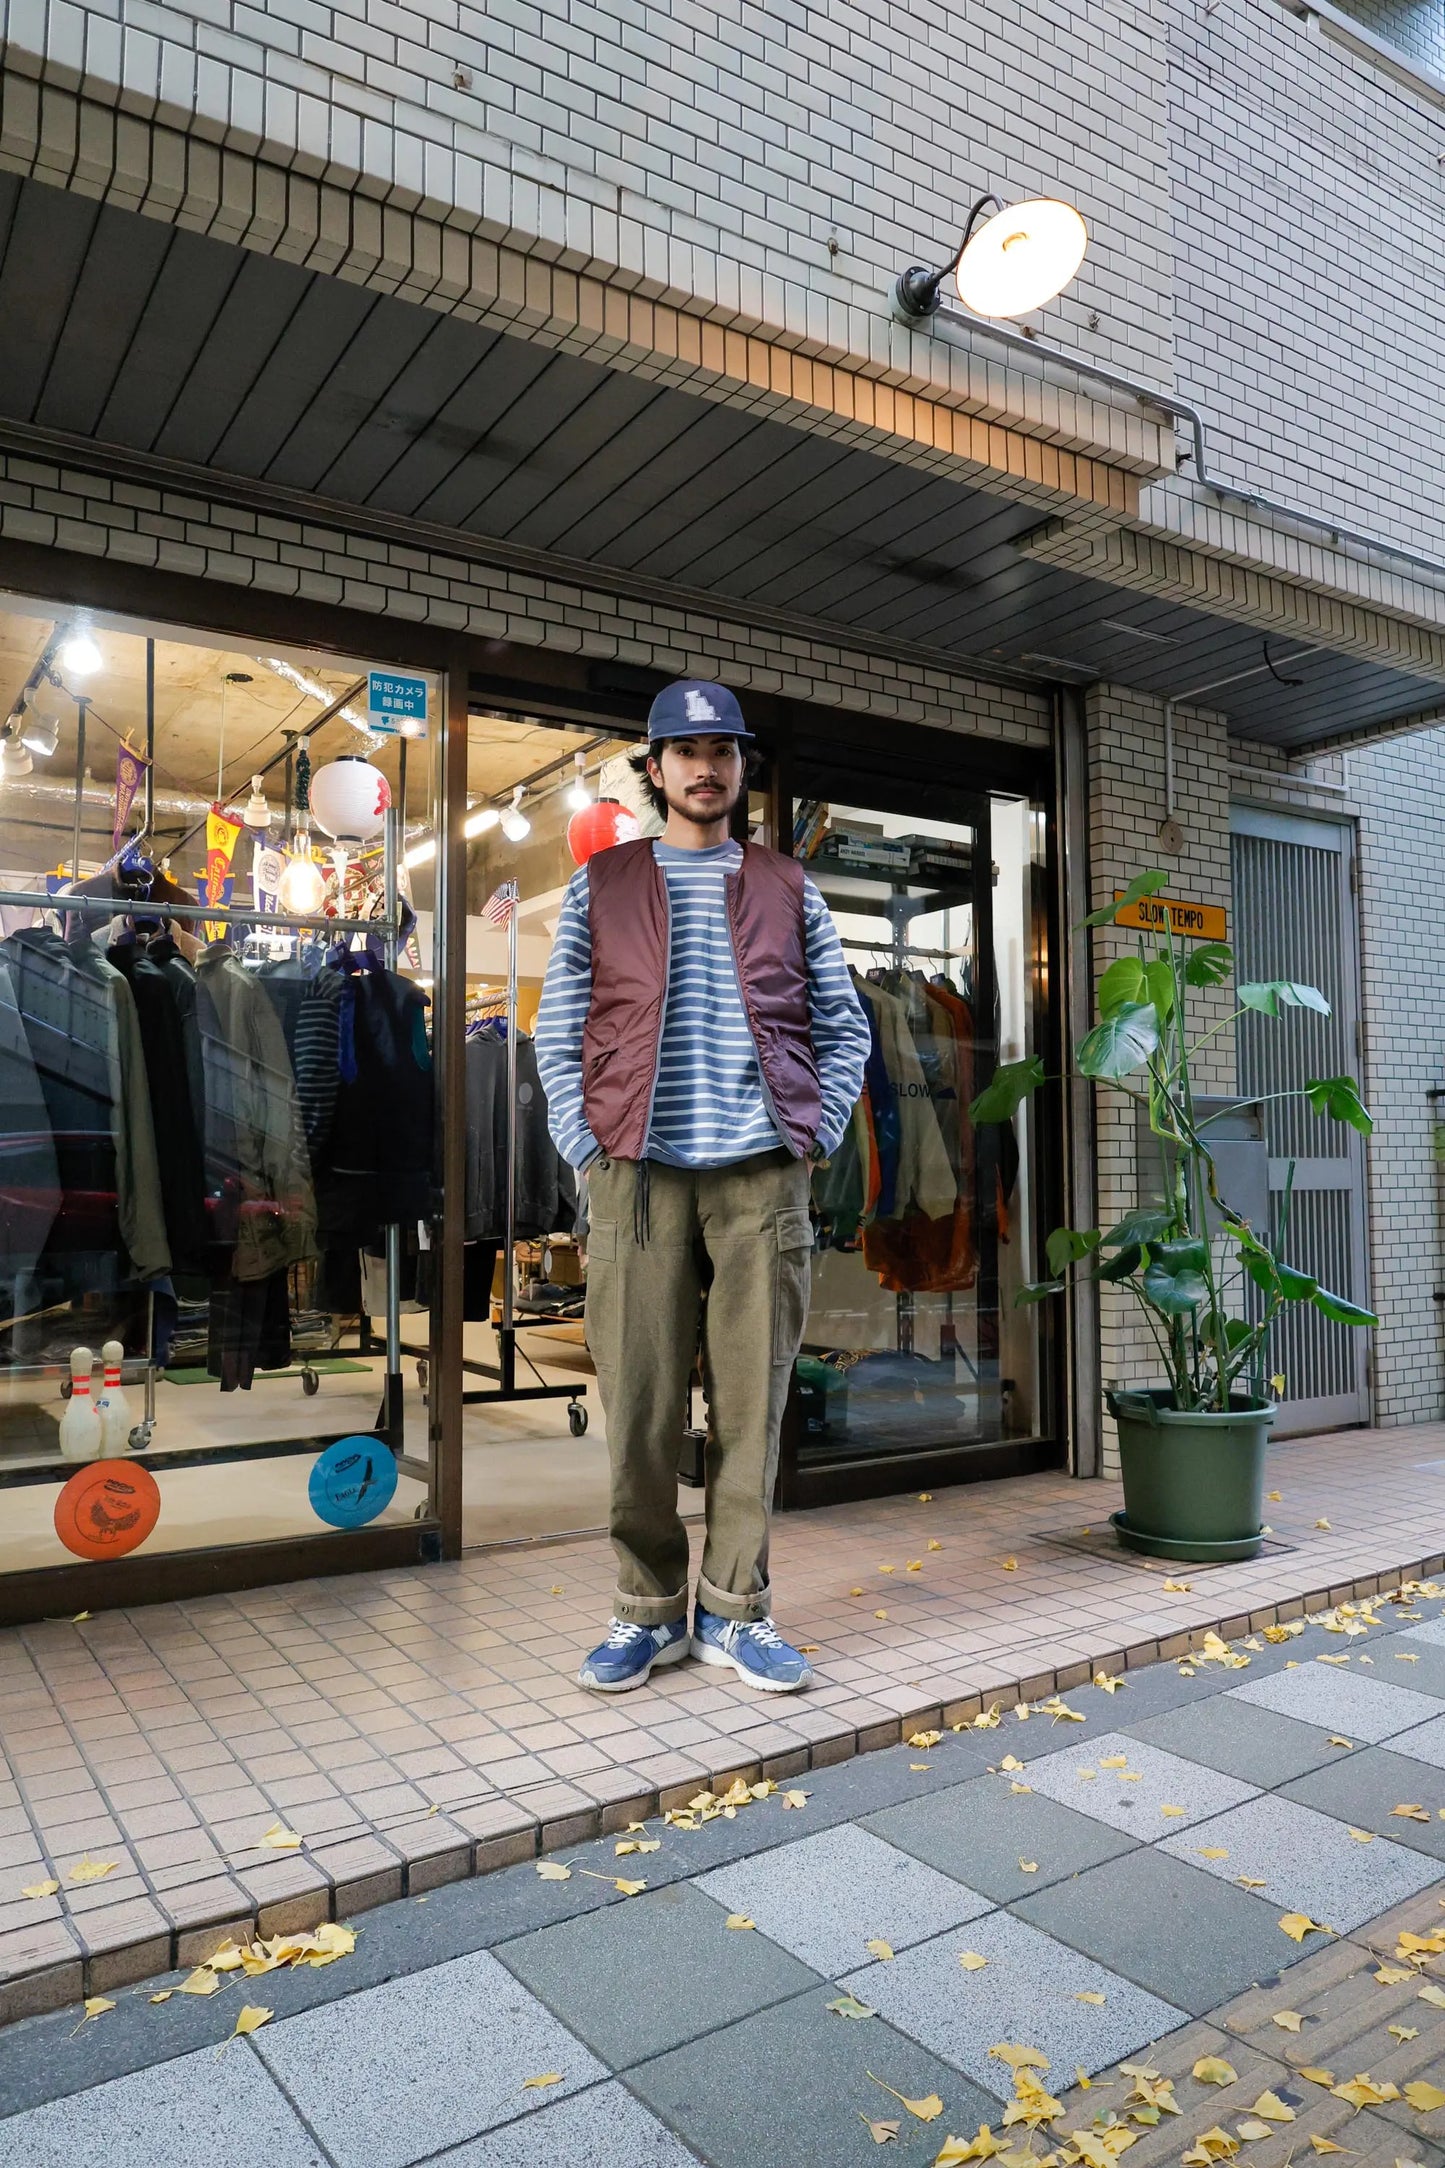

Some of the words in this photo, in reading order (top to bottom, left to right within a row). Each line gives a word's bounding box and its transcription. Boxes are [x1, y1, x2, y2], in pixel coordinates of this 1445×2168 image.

[372, 680, 424, 698] 防犯カメラ
[382, 696, 414, 711] 録画中
[1138, 902, 1165, 924] SLOW
[1170, 907, 1204, 930] TEMPO
[889, 1082, 934, 1099] SLOW
